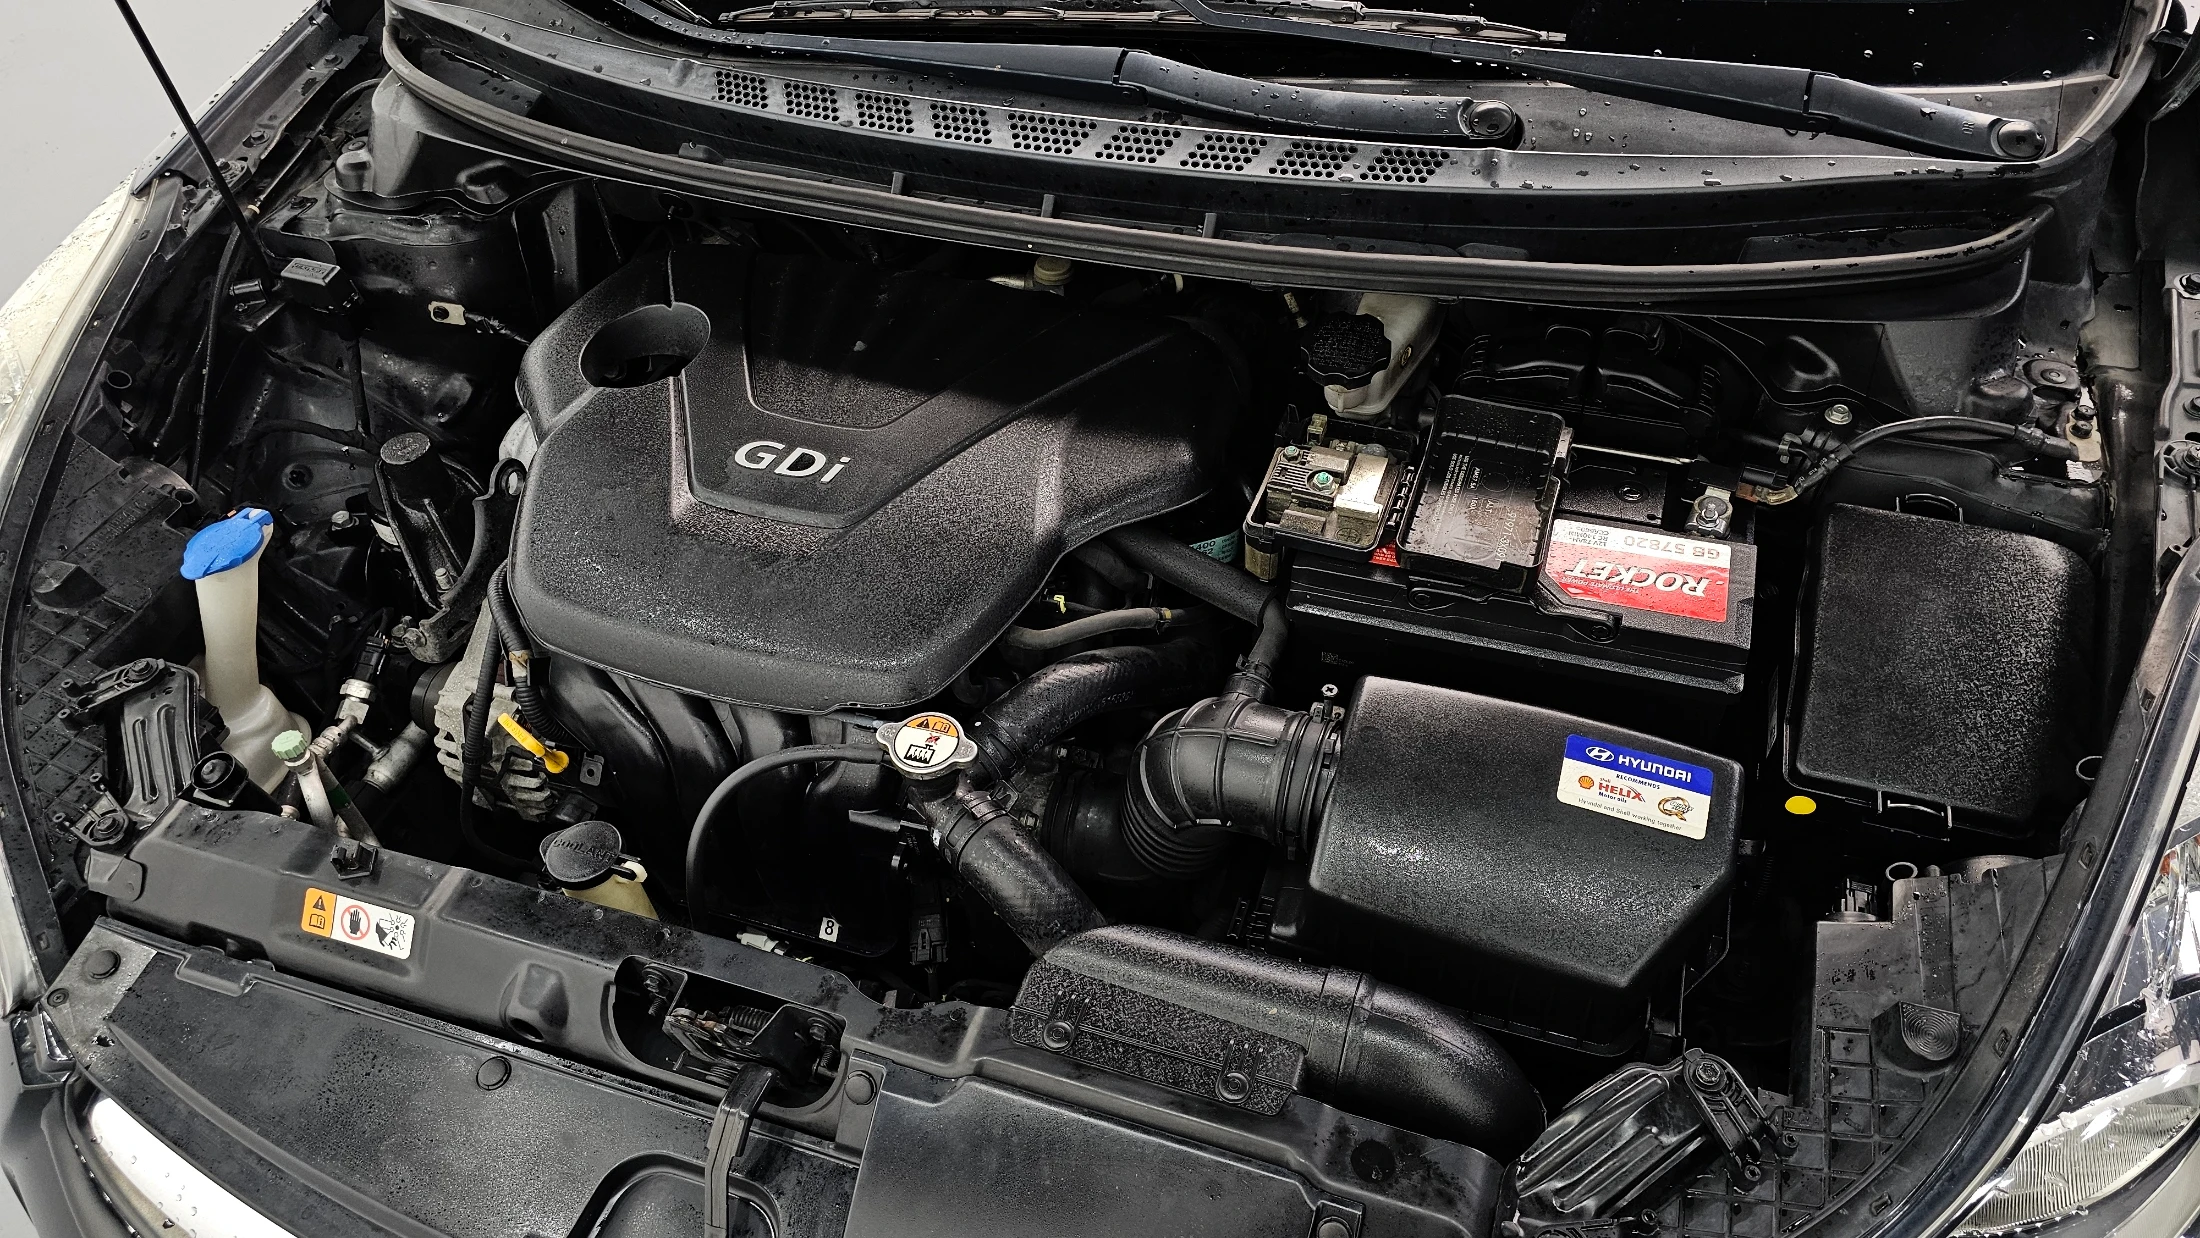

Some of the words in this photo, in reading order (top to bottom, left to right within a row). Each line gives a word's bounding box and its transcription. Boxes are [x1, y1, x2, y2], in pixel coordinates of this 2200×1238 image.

[735, 441, 851, 484] GDi
[1624, 535, 1686, 555] 57820
[1692, 546, 1720, 560] GB
[1565, 558, 1712, 597] ROCKET
[1618, 754, 1692, 783] HYUNDAI
[1598, 781, 1643, 803] HELIX
[1616, 773, 1661, 790] RECOMMENDS
[1598, 791, 1616, 801] Motor
[1578, 797, 1602, 811] Hyundai
[1604, 803, 1615, 812] and
[1616, 806, 1631, 817] Shell
[1632, 811, 1655, 825] working
[1657, 818, 1682, 831] together
[553, 839, 616, 862] COOLANT
[824, 919, 835, 936] 8
